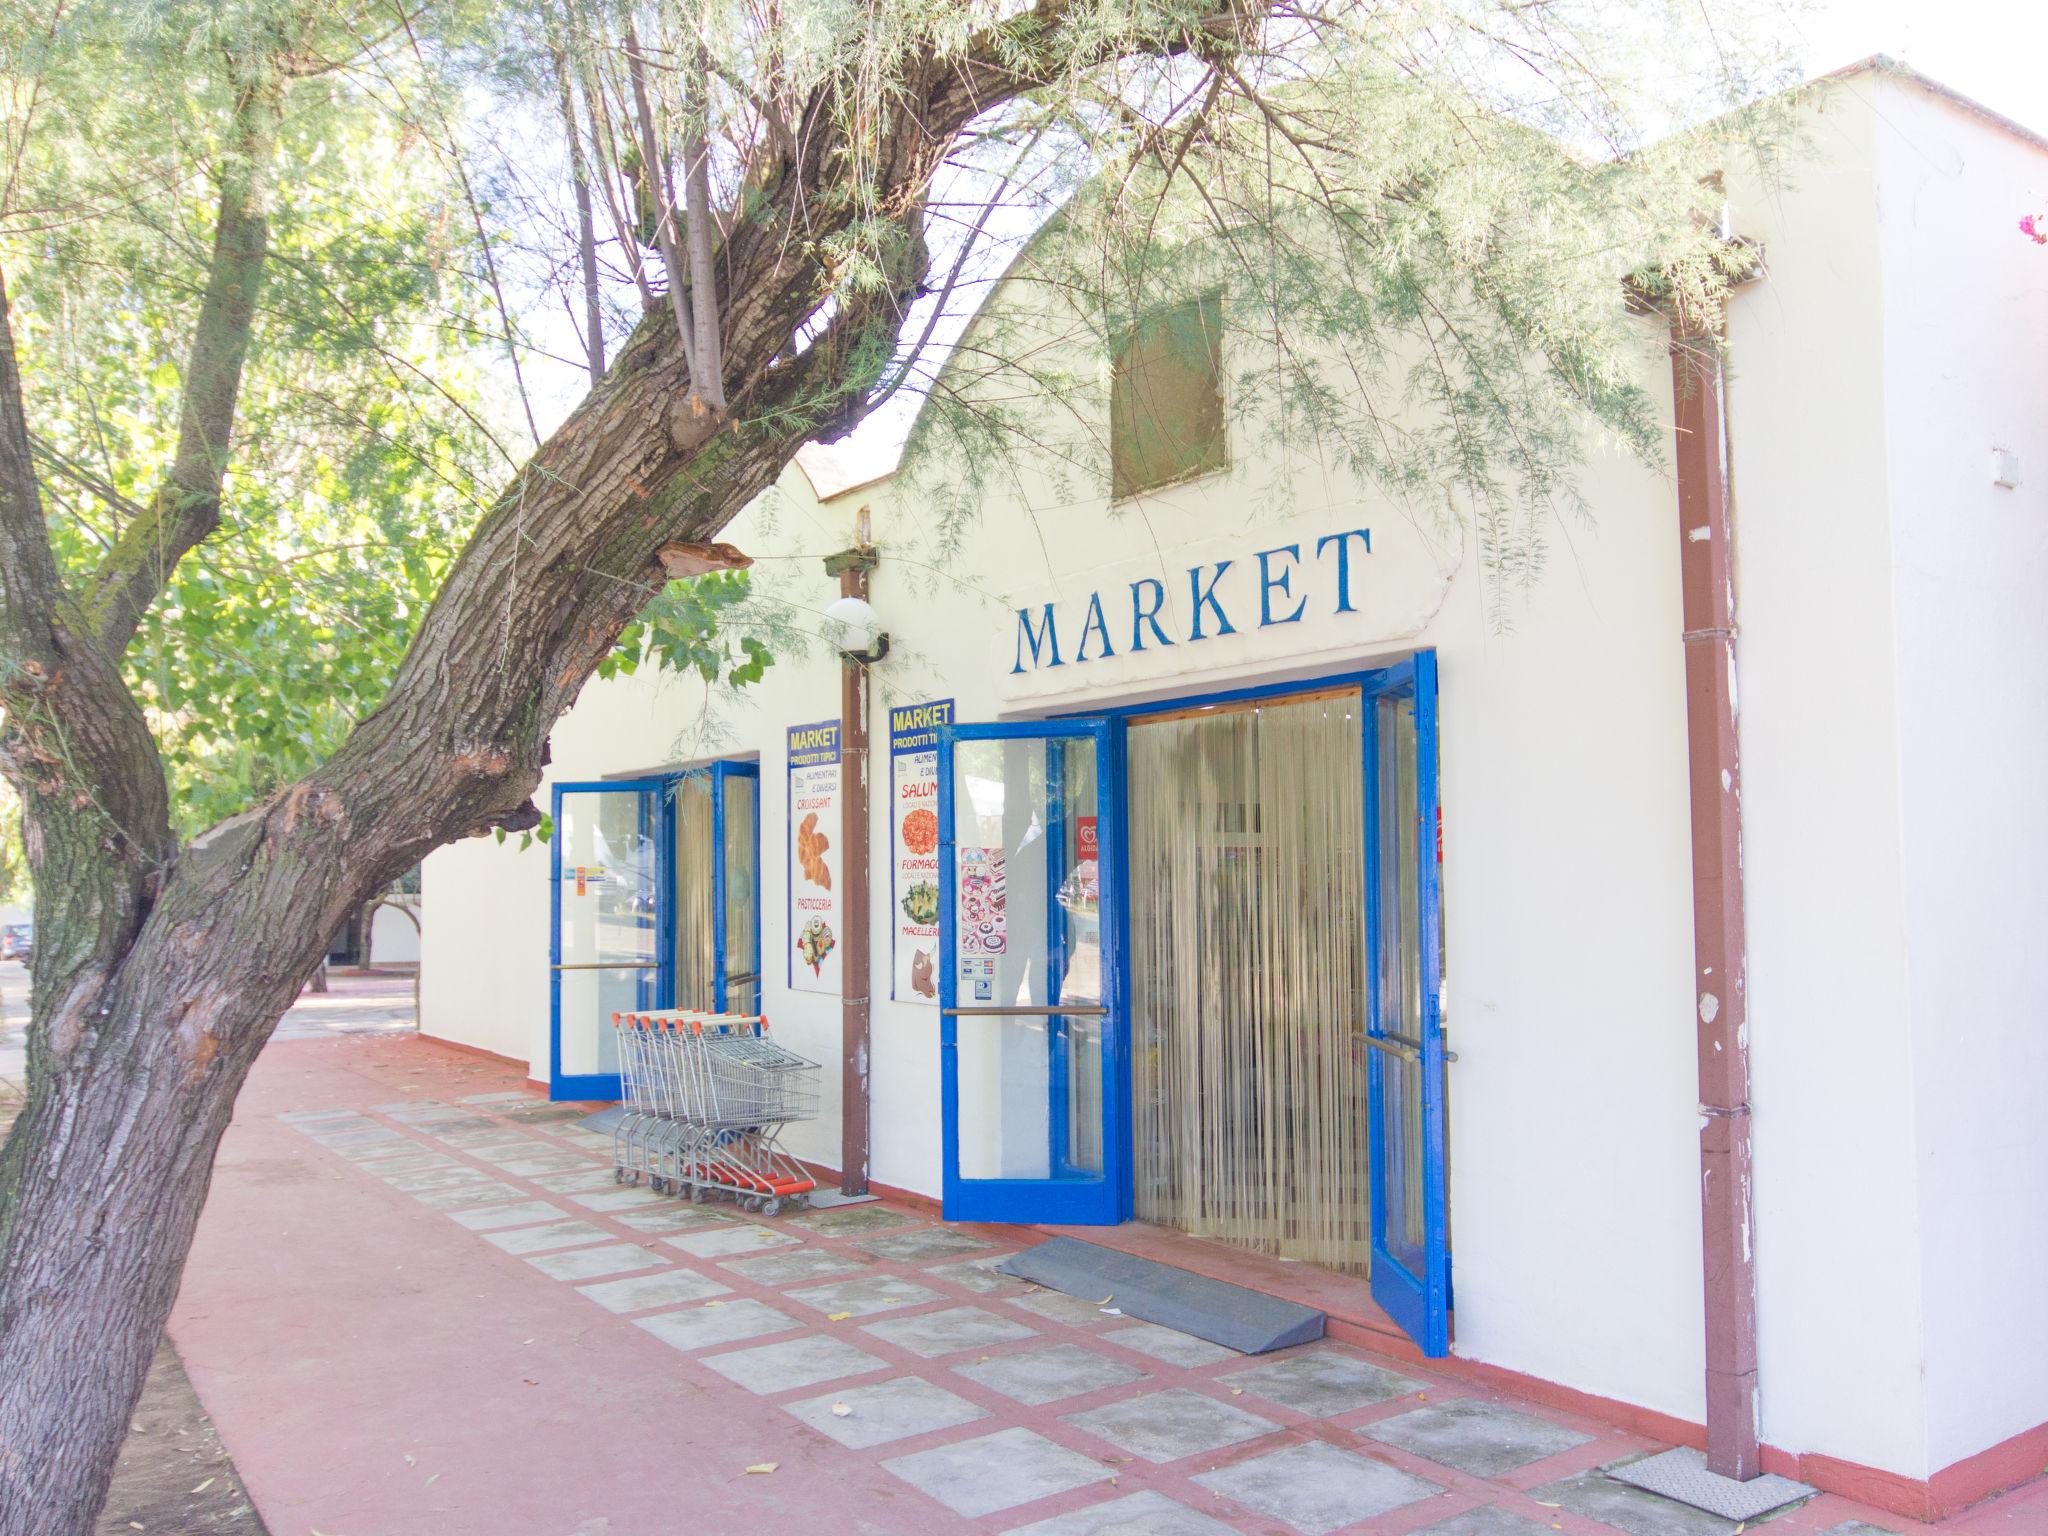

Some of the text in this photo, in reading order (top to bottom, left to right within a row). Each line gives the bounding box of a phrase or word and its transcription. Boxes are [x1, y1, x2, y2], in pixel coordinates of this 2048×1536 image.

[1009, 527, 1371, 674] MARKET
[893, 703, 951, 732] MARKET
[791, 727, 838, 751] MARKET
[893, 734, 928, 749] PRODOTTI
[791, 753, 820, 766] PRODOTTI
[806, 770, 837, 780] ALIMENTARI
[797, 797, 831, 810] CROISSANT
[797, 897, 832, 910] PASTICCERIA
